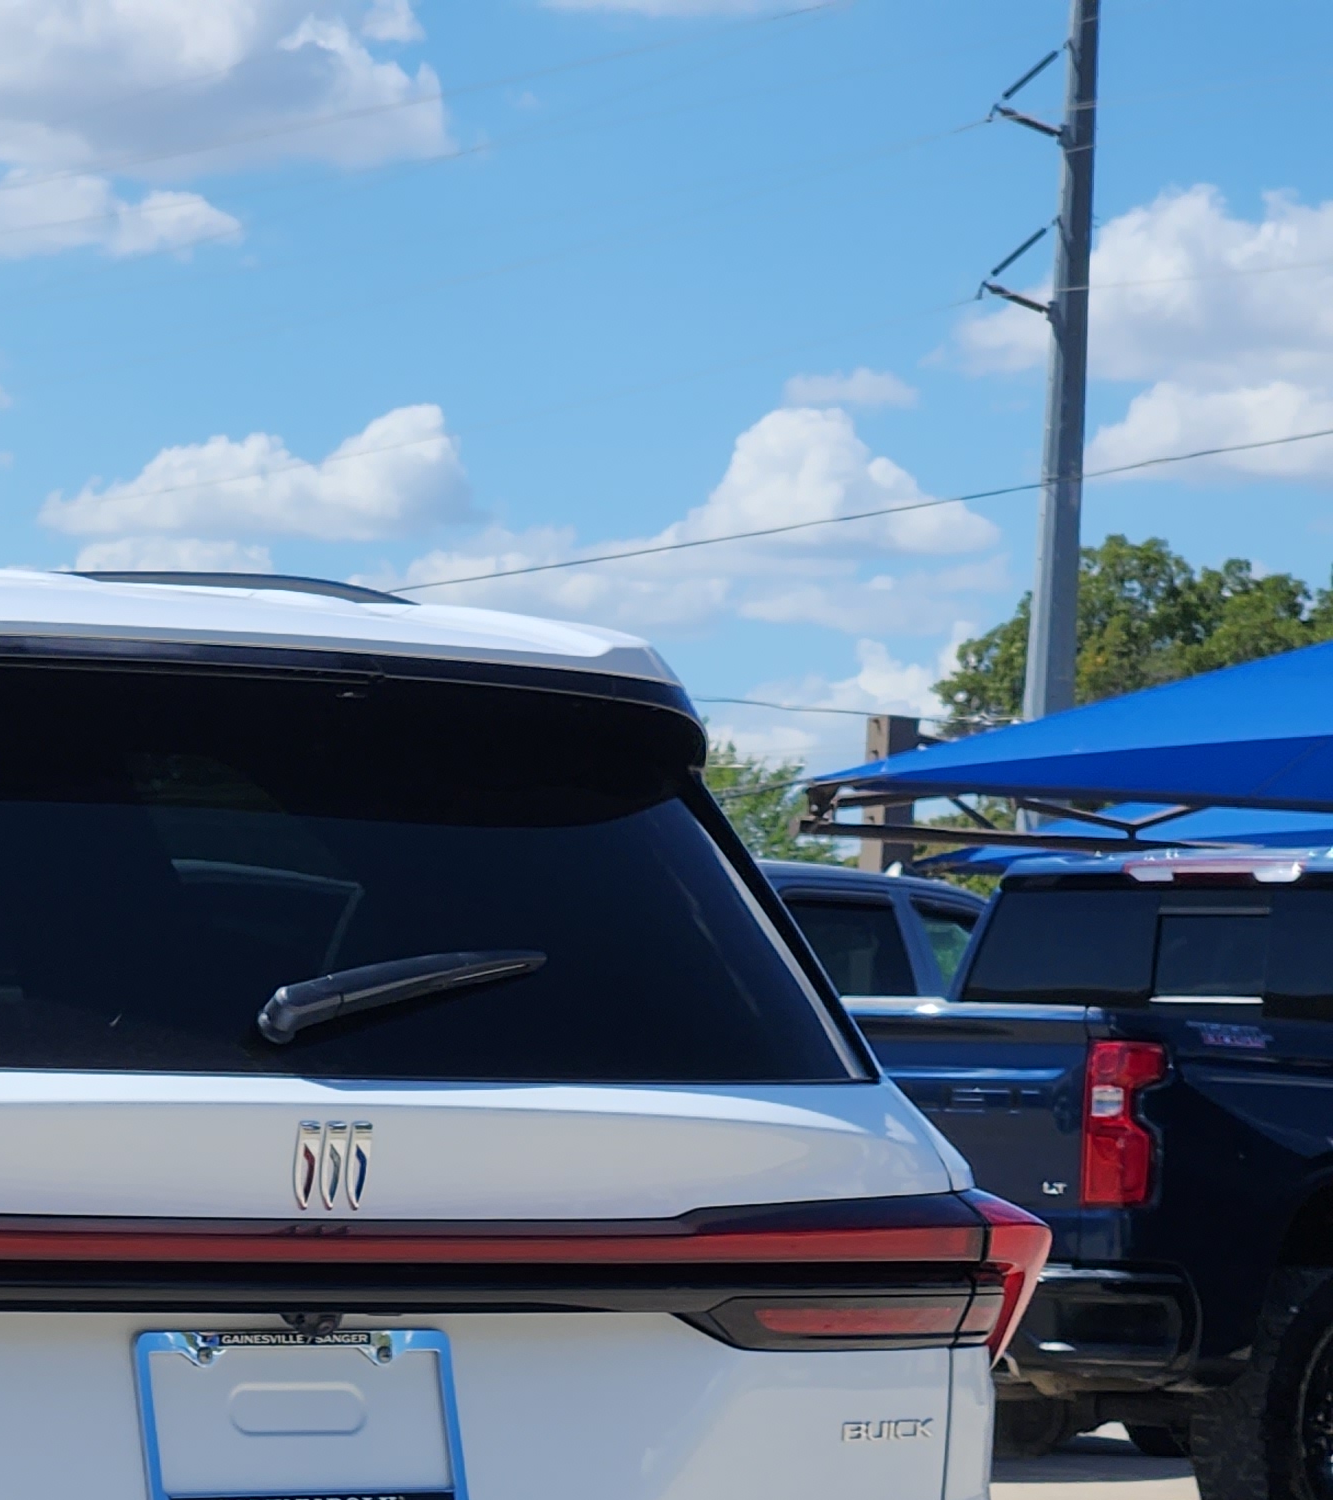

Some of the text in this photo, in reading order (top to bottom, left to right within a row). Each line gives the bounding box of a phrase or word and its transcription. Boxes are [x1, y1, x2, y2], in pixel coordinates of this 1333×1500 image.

[221, 1334, 304, 1345] GAINESVILLE
[314, 1333, 369, 1344] SANGER
[841, 1417, 934, 1441] BUICK
